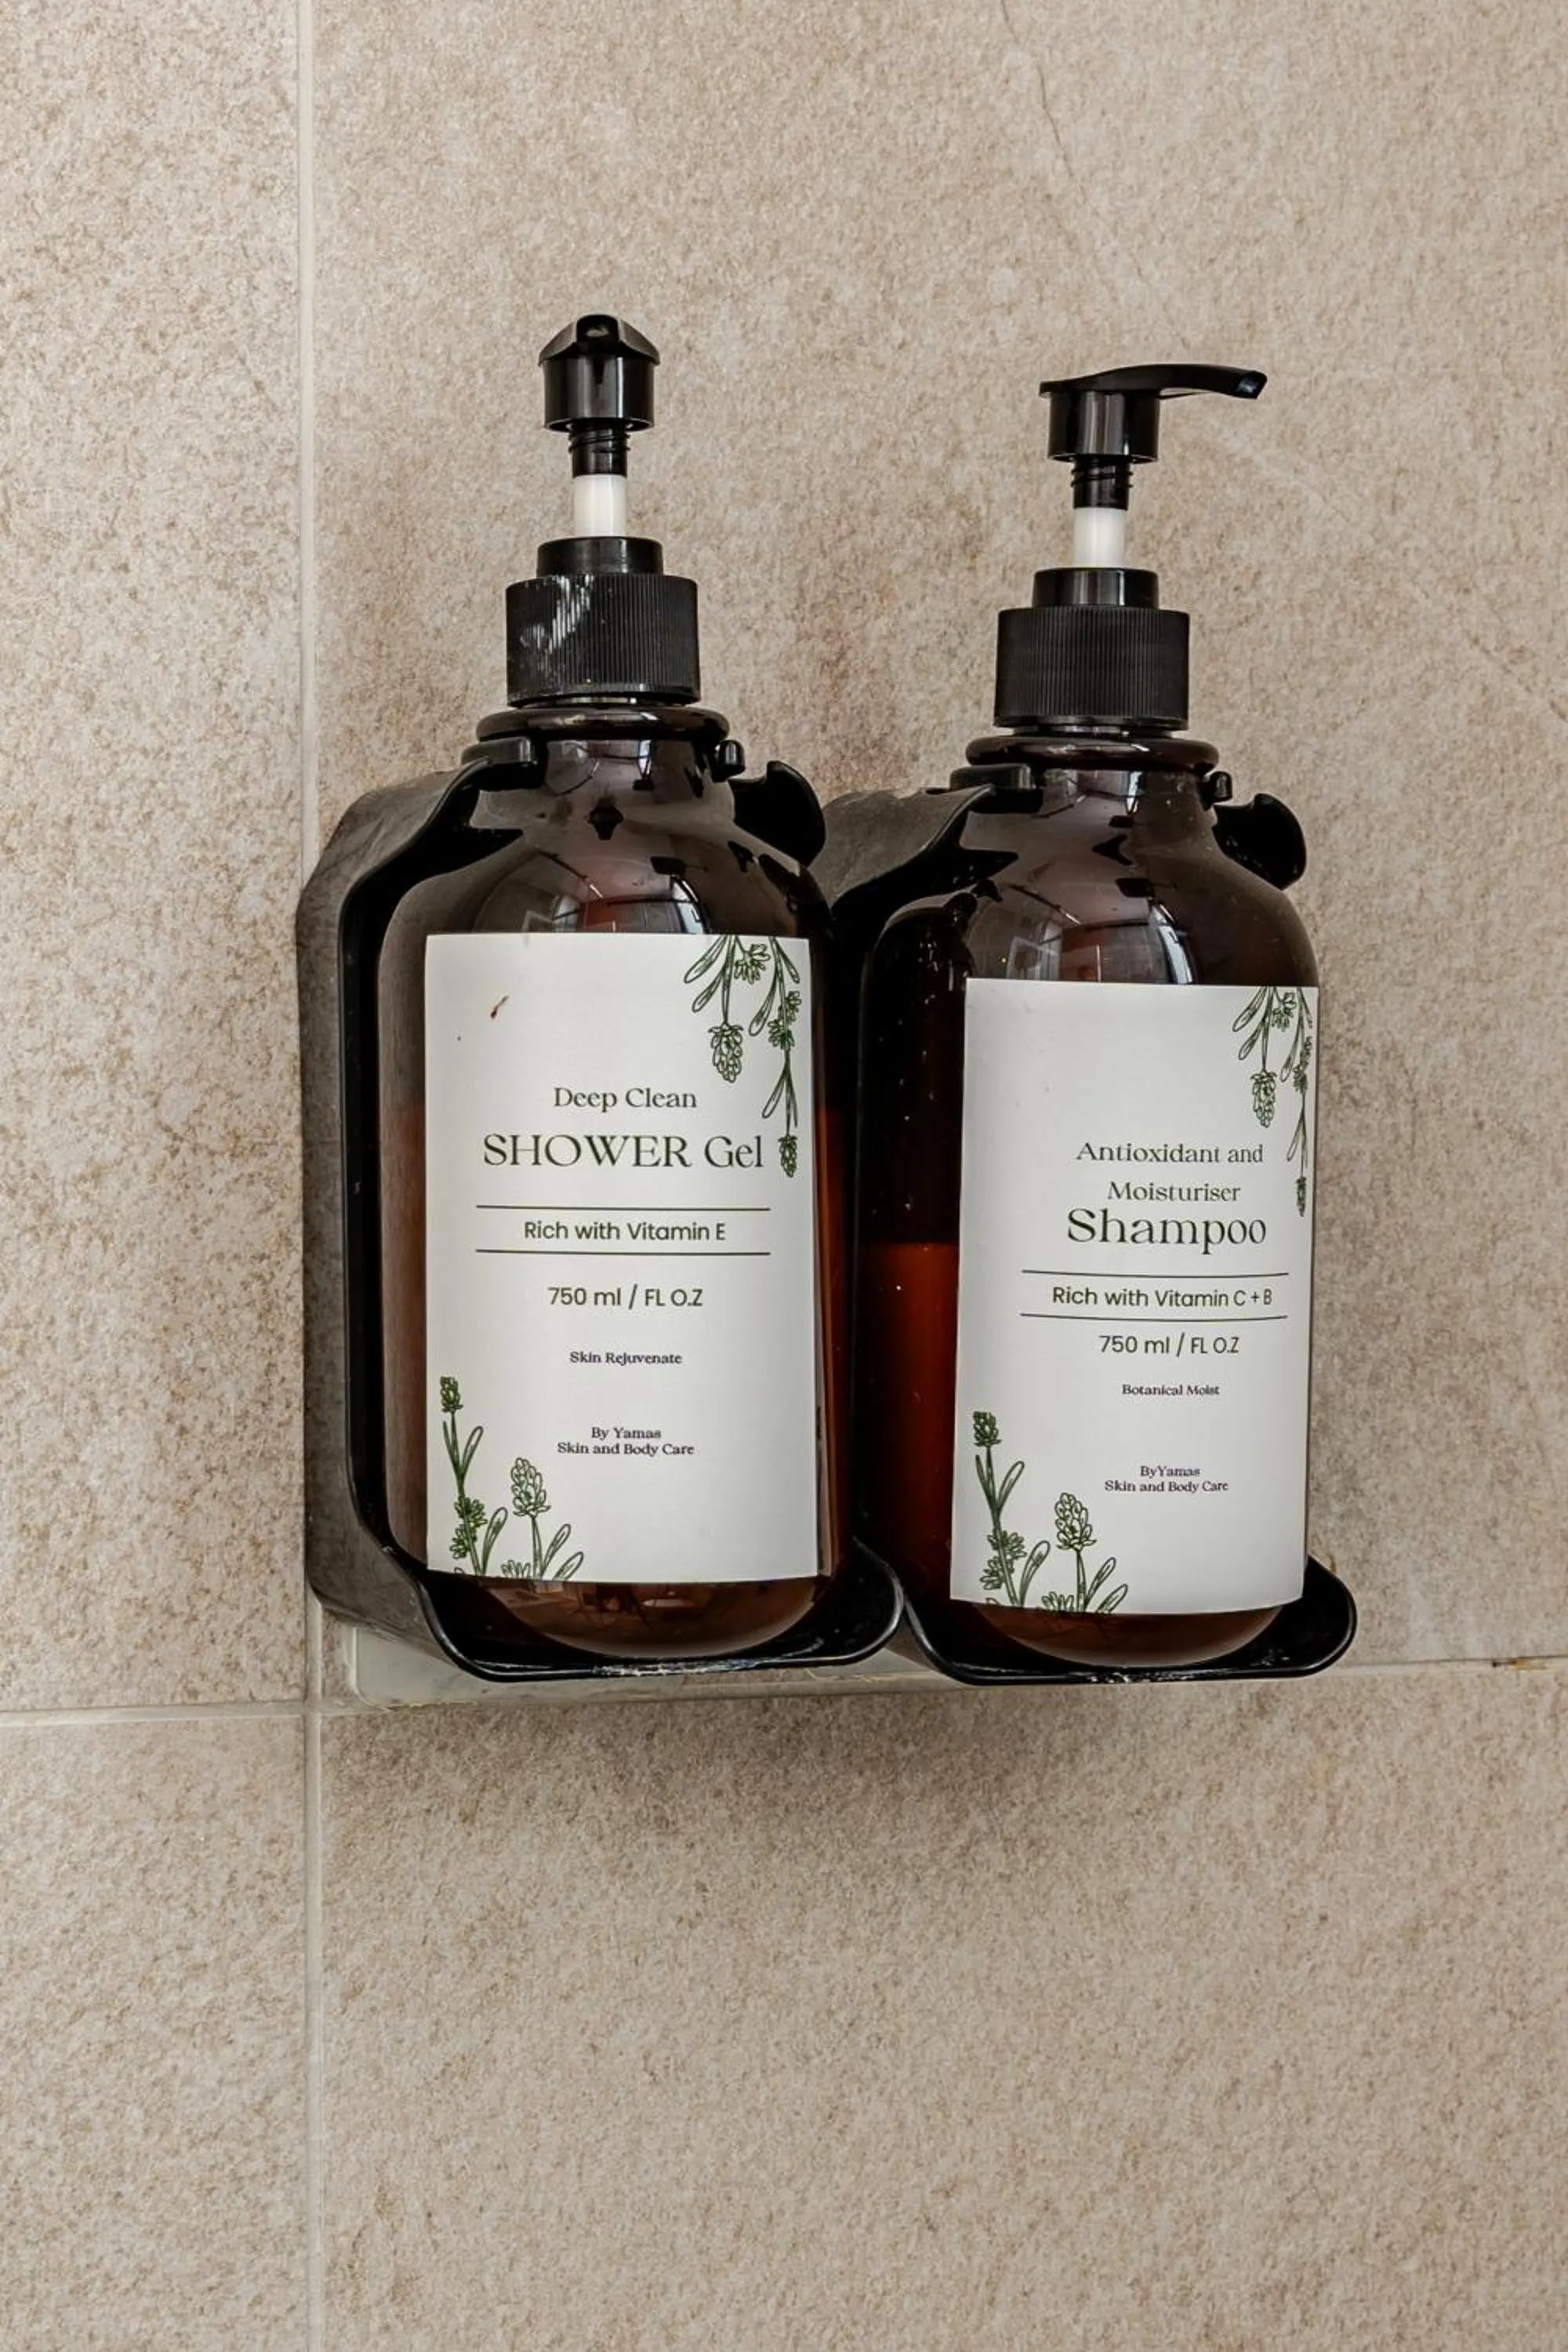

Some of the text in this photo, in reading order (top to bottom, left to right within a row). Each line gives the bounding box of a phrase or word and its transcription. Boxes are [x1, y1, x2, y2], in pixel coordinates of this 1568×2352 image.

[554, 1087, 698, 1114] Deep Clean
[483, 1132, 764, 1169] SHOWER Gel
[1075, 1141, 1264, 1164] Antioxidant and
[1106, 1180, 1242, 1203] Moisturiser
[524, 1219, 726, 1242] Rich with Vitamin E
[1066, 1207, 1267, 1256] Shampoo
[546, 1286, 588, 1306] 750
[593, 1287, 622, 1307] ml
[644, 1288, 666, 1308] FL
[1052, 1285, 1098, 1305] Rich
[1103, 1287, 1149, 1308] with
[1153, 1288, 1229, 1308] Vitamin
[1098, 1334, 1138, 1354] 750
[1143, 1335, 1171, 1355] ml
[1190, 1336, 1209, 1355] FL
[568, 1350, 684, 1367] Skin Rejuvenate
[1121, 1383, 1221, 1397] Botanical Moist
[590, 1426, 662, 1442] By Yamas
[557, 1441, 695, 1458] Skin and Body Care
[1104, 1479, 1229, 1495] Skin and Body Care
